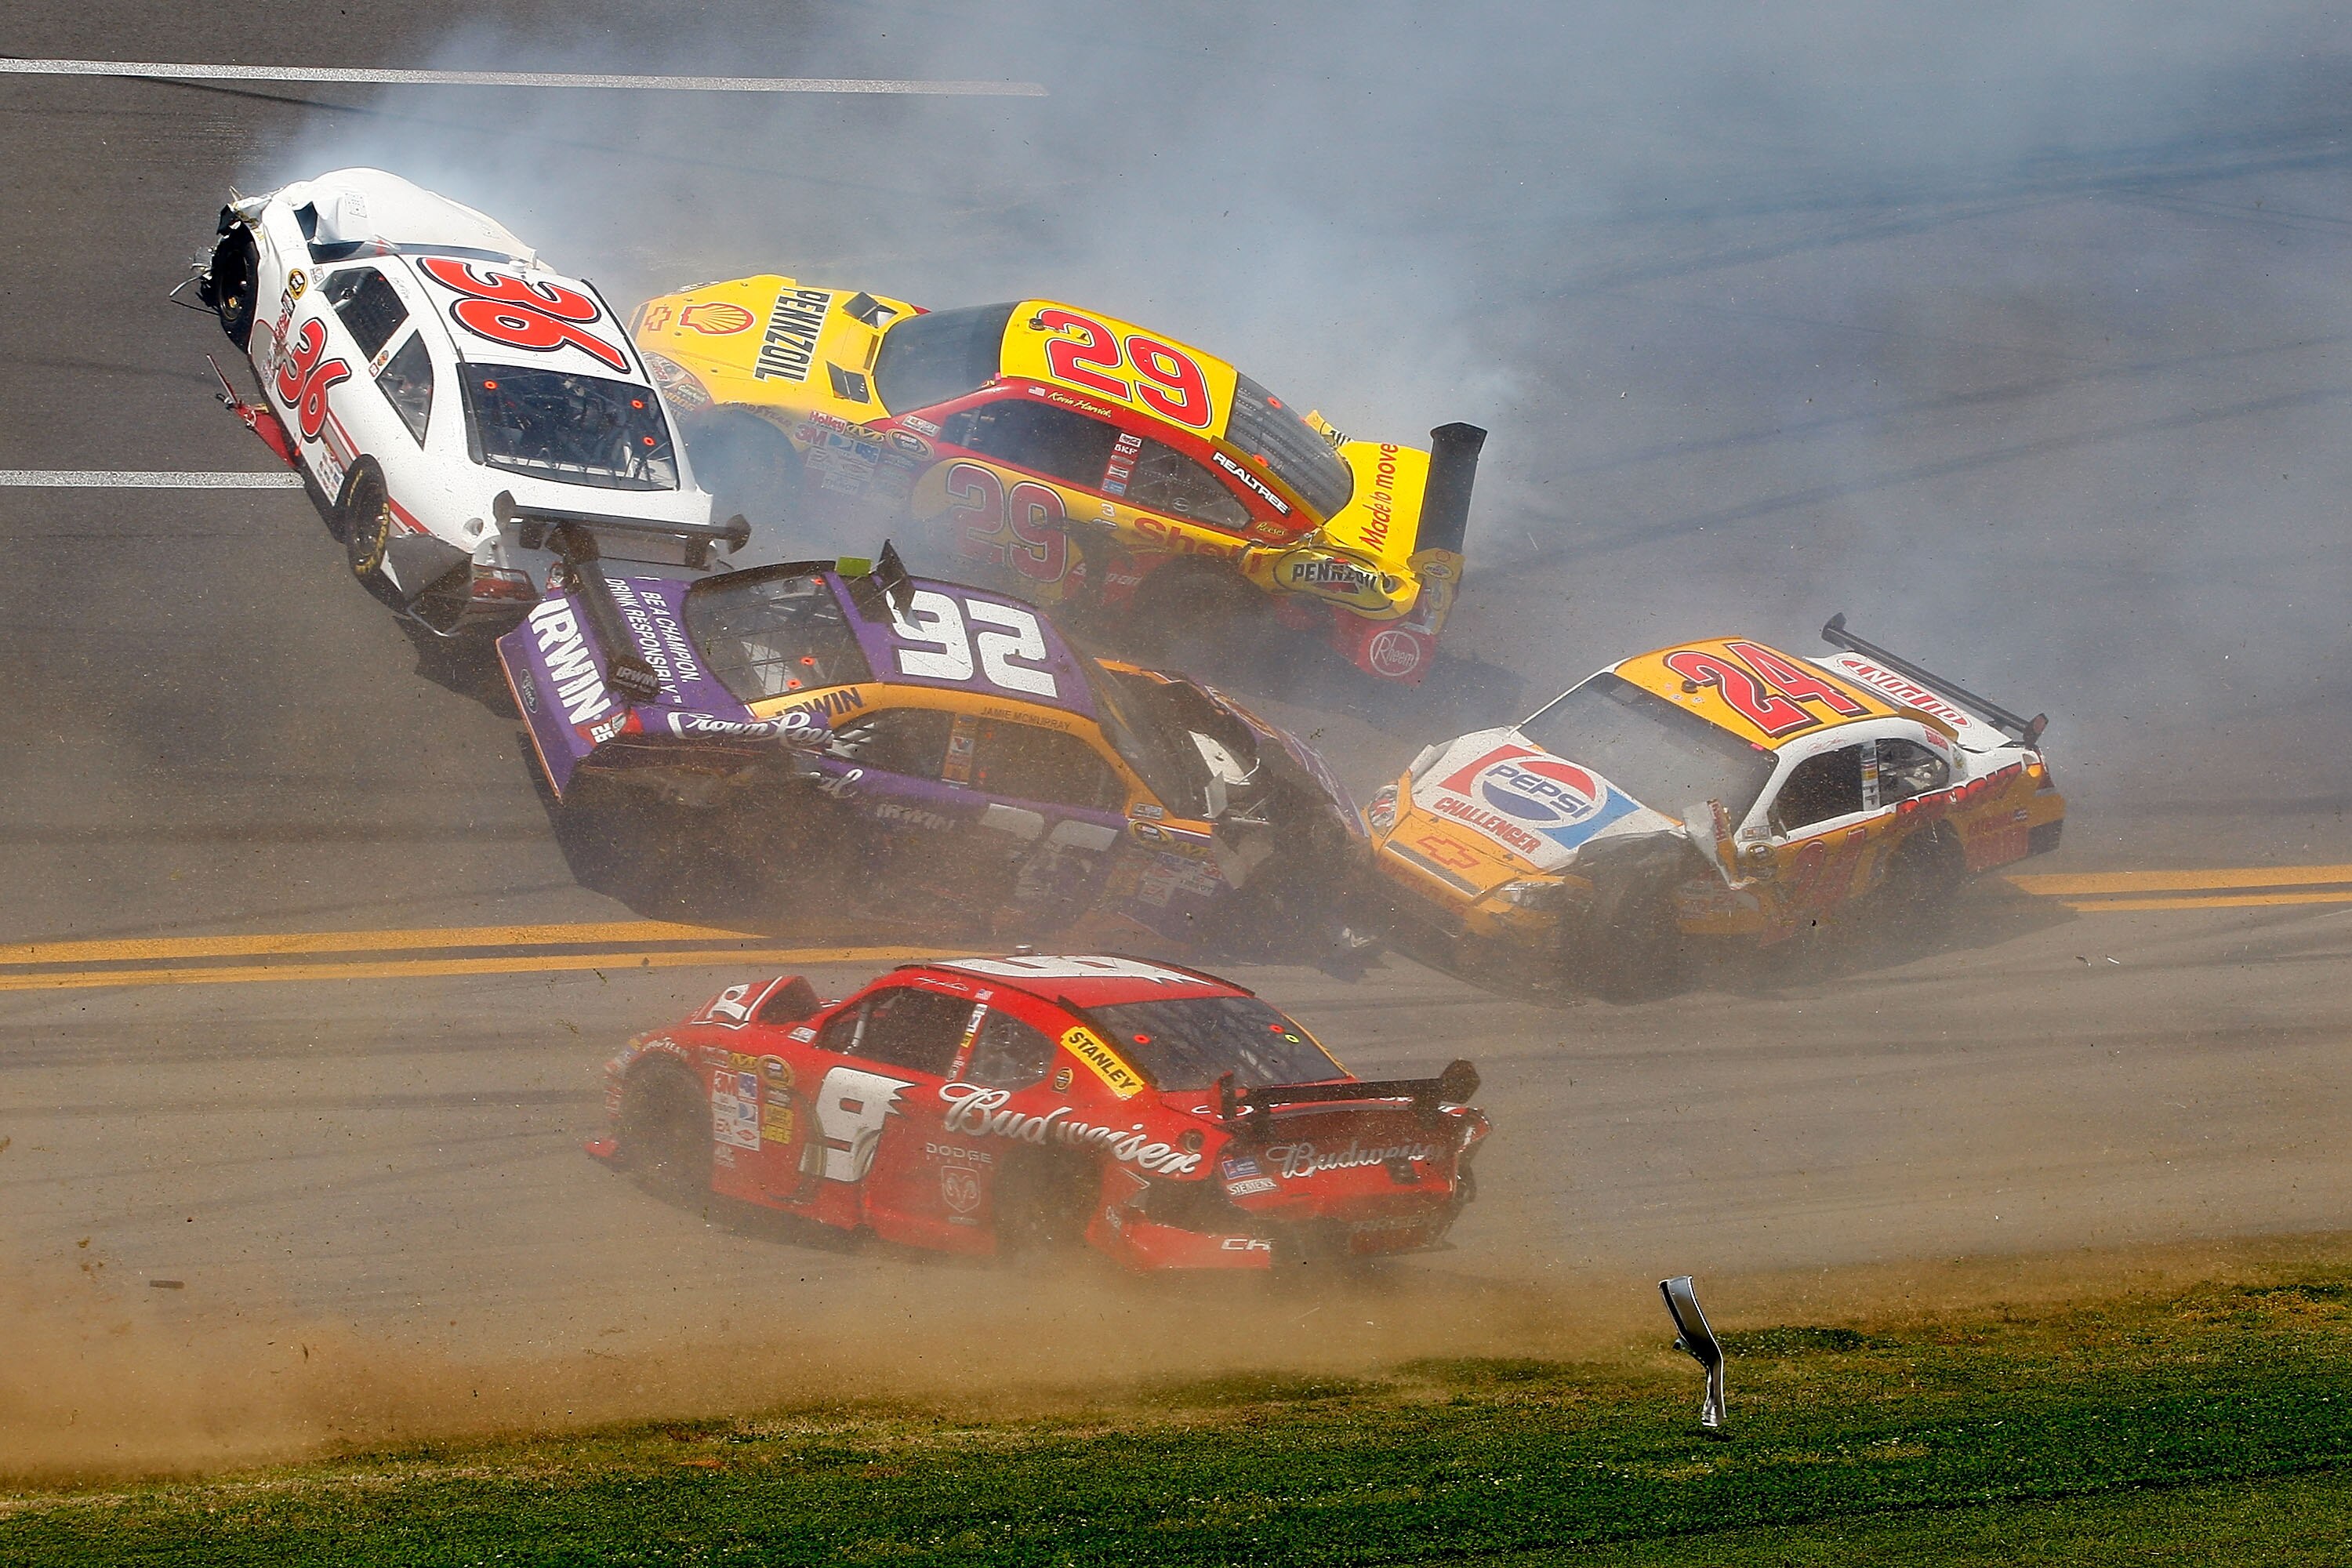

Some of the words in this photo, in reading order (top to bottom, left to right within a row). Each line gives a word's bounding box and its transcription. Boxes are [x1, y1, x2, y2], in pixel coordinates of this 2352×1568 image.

[418, 257, 630, 374] 36
[753, 286, 831, 383] PENNZOIL
[275, 317, 352, 444] 36
[1037, 308, 1211, 428] 29
[1047, 392, 1074, 405] Kevin
[795, 424, 828, 445] 3M
[1212, 452, 1288, 514] REALTREE
[1359, 503, 1392, 553] Made
[1376, 444, 1399, 489] move
[948, 463, 1066, 583] 29
[604, 578, 641, 608] DRINK
[640, 591, 666, 607] BE
[649, 606, 670, 616] A
[528, 597, 612, 725] IRWIN
[655, 617, 702, 683] CHAMPION.
[1374, 633, 1414, 666] Rheem
[775, 687, 864, 717] WIN
[1663, 640, 1872, 740] 24
[1850, 665, 1958, 722] DUPONT
[590, 722, 615, 743] 26
[981, 707, 1012, 719] JAMIE
[1014, 710, 1072, 731] MCMURRAY
[1486, 764, 1593, 819] PEPSI
[1433, 796, 1541, 854] CHALLENGER
[1069, 1032, 1137, 1089] STANLEY
[799, 1066, 916, 1181] 9
[938, 1082, 1202, 1174] Budweiser
[927, 1142, 993, 1164] DODGE
[1229, 1178, 1277, 1196] SIEMENS
